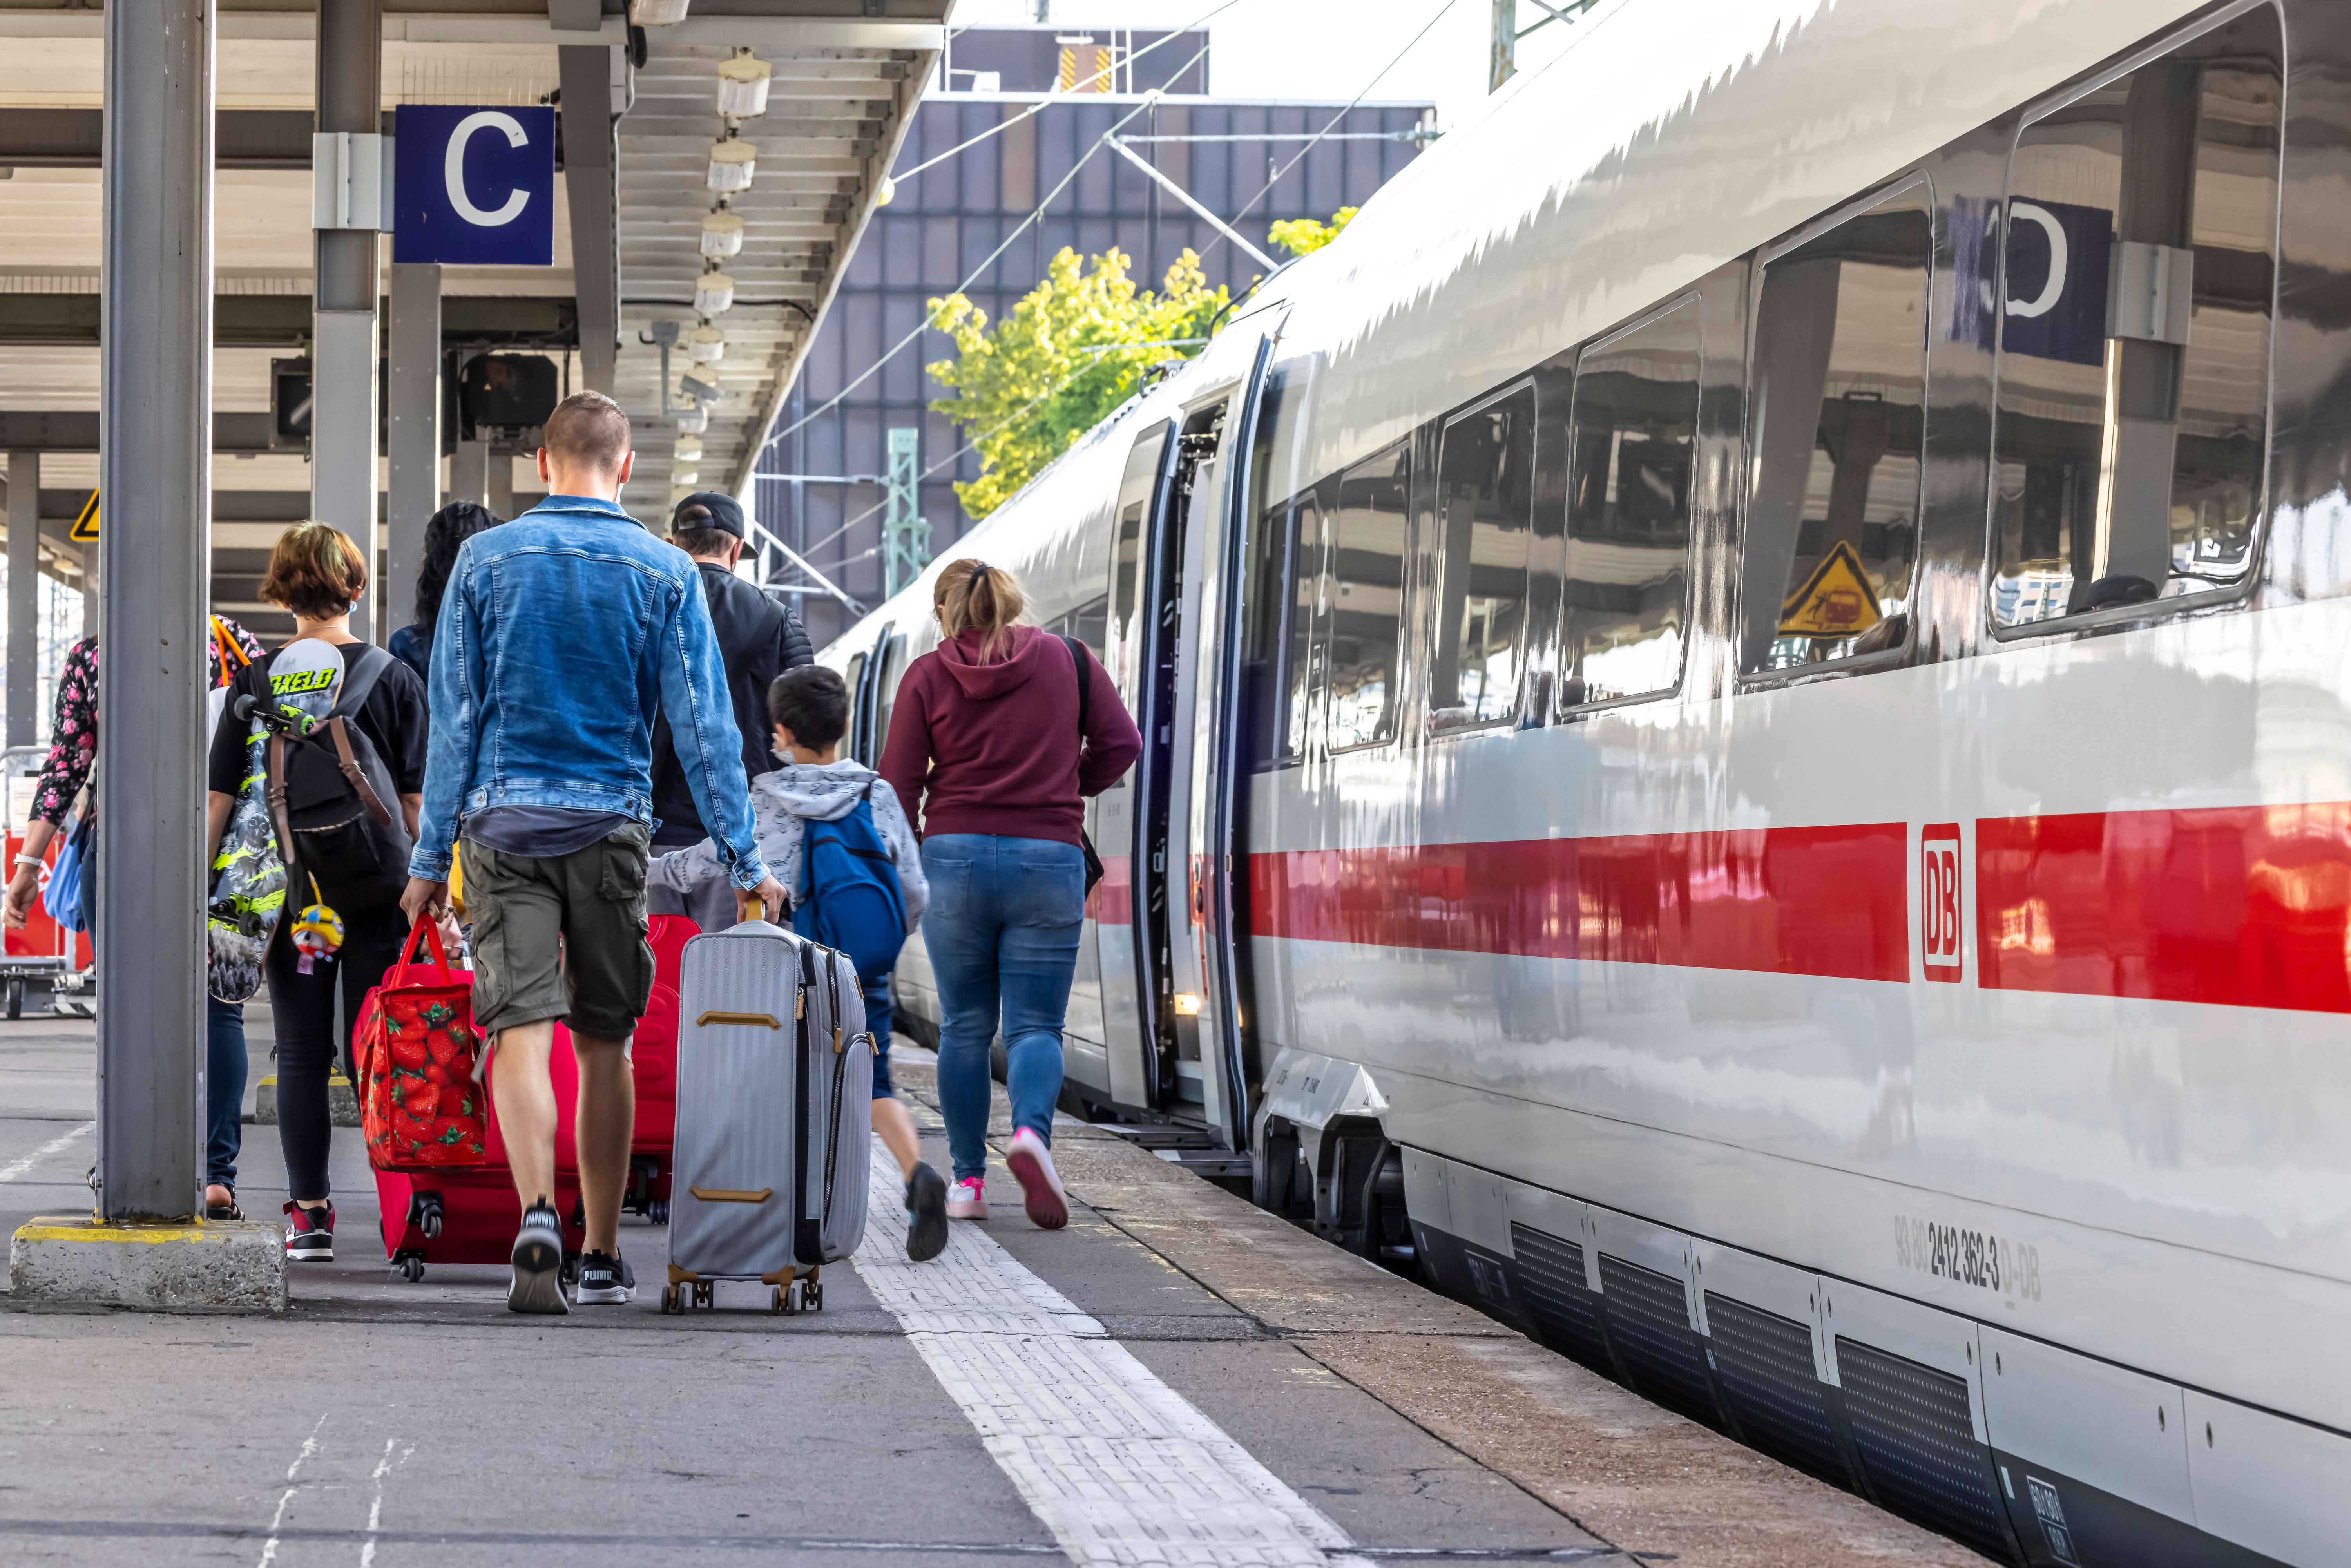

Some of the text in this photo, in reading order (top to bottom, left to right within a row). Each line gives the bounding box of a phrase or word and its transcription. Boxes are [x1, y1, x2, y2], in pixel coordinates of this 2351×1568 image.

[445, 111, 530, 226] C
[1318, 517, 1329, 617] 2
[1926, 851, 1957, 955] DB
[585, 1270, 612, 1280] PUMA
[1894, 1213, 1911, 1267] 93
[1911, 1218, 1928, 1273] 80
[1929, 1222, 1960, 1281] 2412
[1961, 1229, 1999, 1292] 362-3
